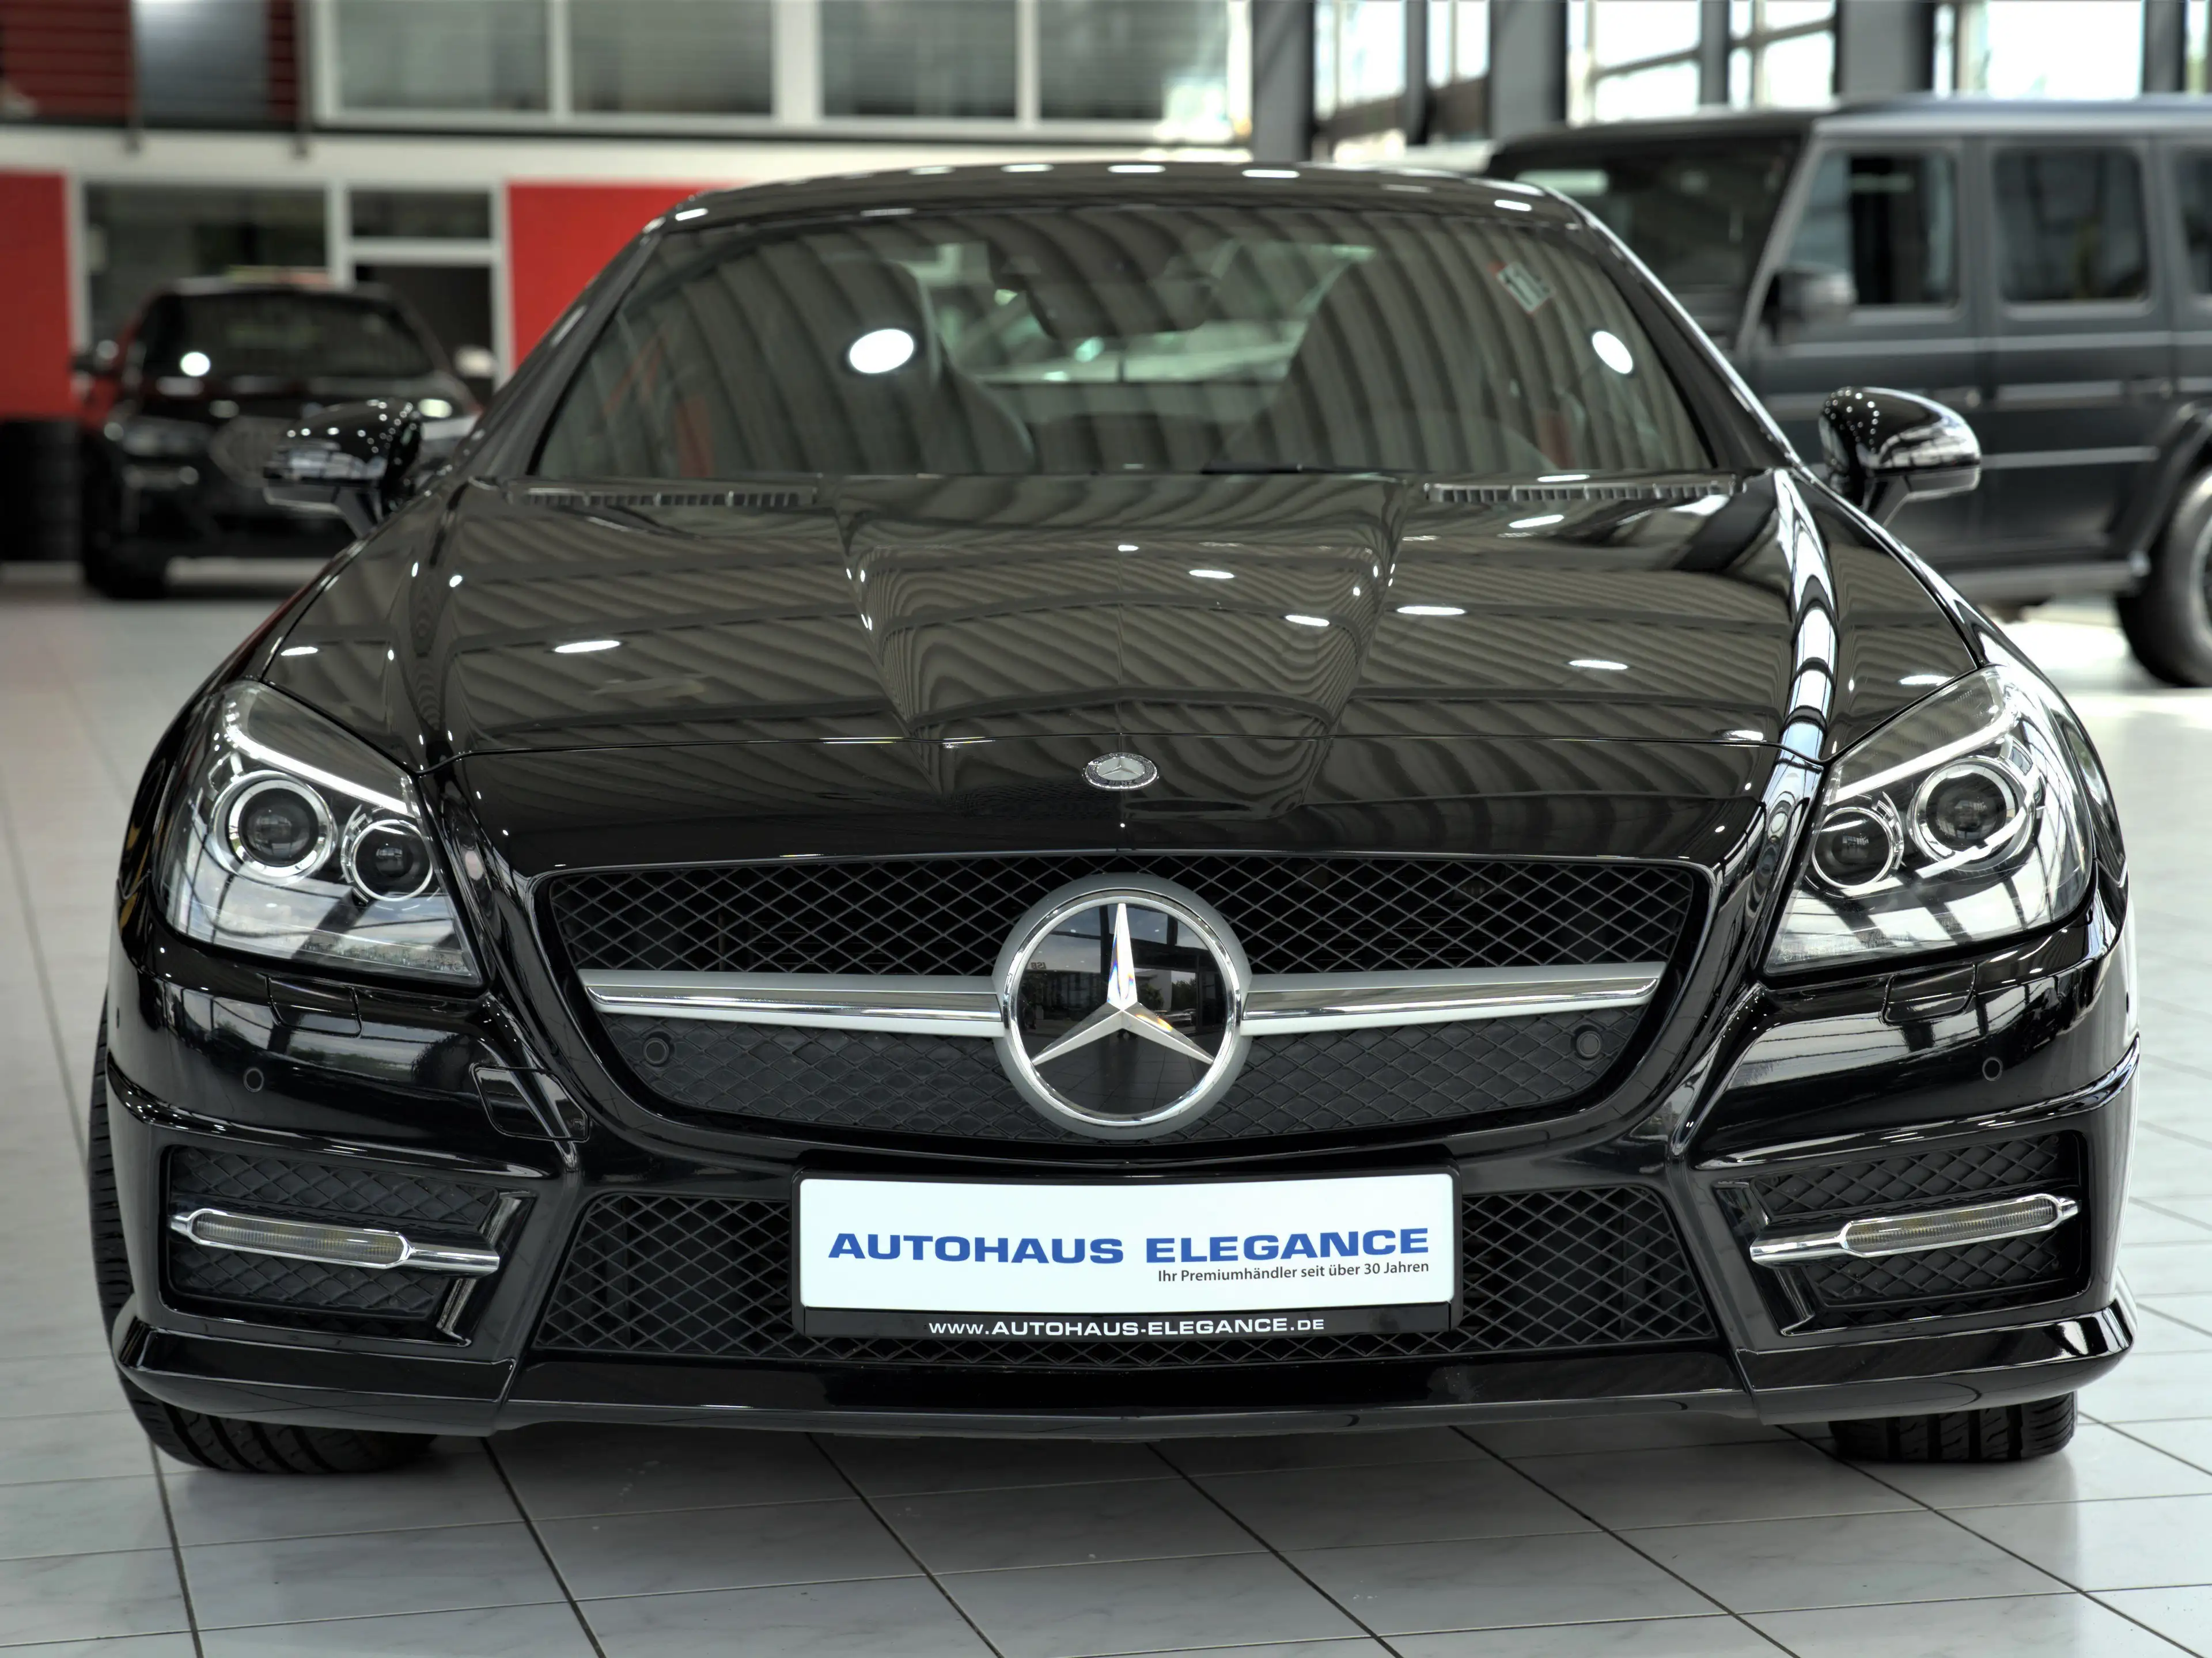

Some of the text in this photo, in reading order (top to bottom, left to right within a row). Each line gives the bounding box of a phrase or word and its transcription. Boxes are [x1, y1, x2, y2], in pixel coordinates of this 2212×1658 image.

[828, 1227, 1429, 1264] AUTOHAUS ELEGANCE
[1158, 1261, 1429, 1282] Ihr Premiumhändler seit über 30 Jahren
